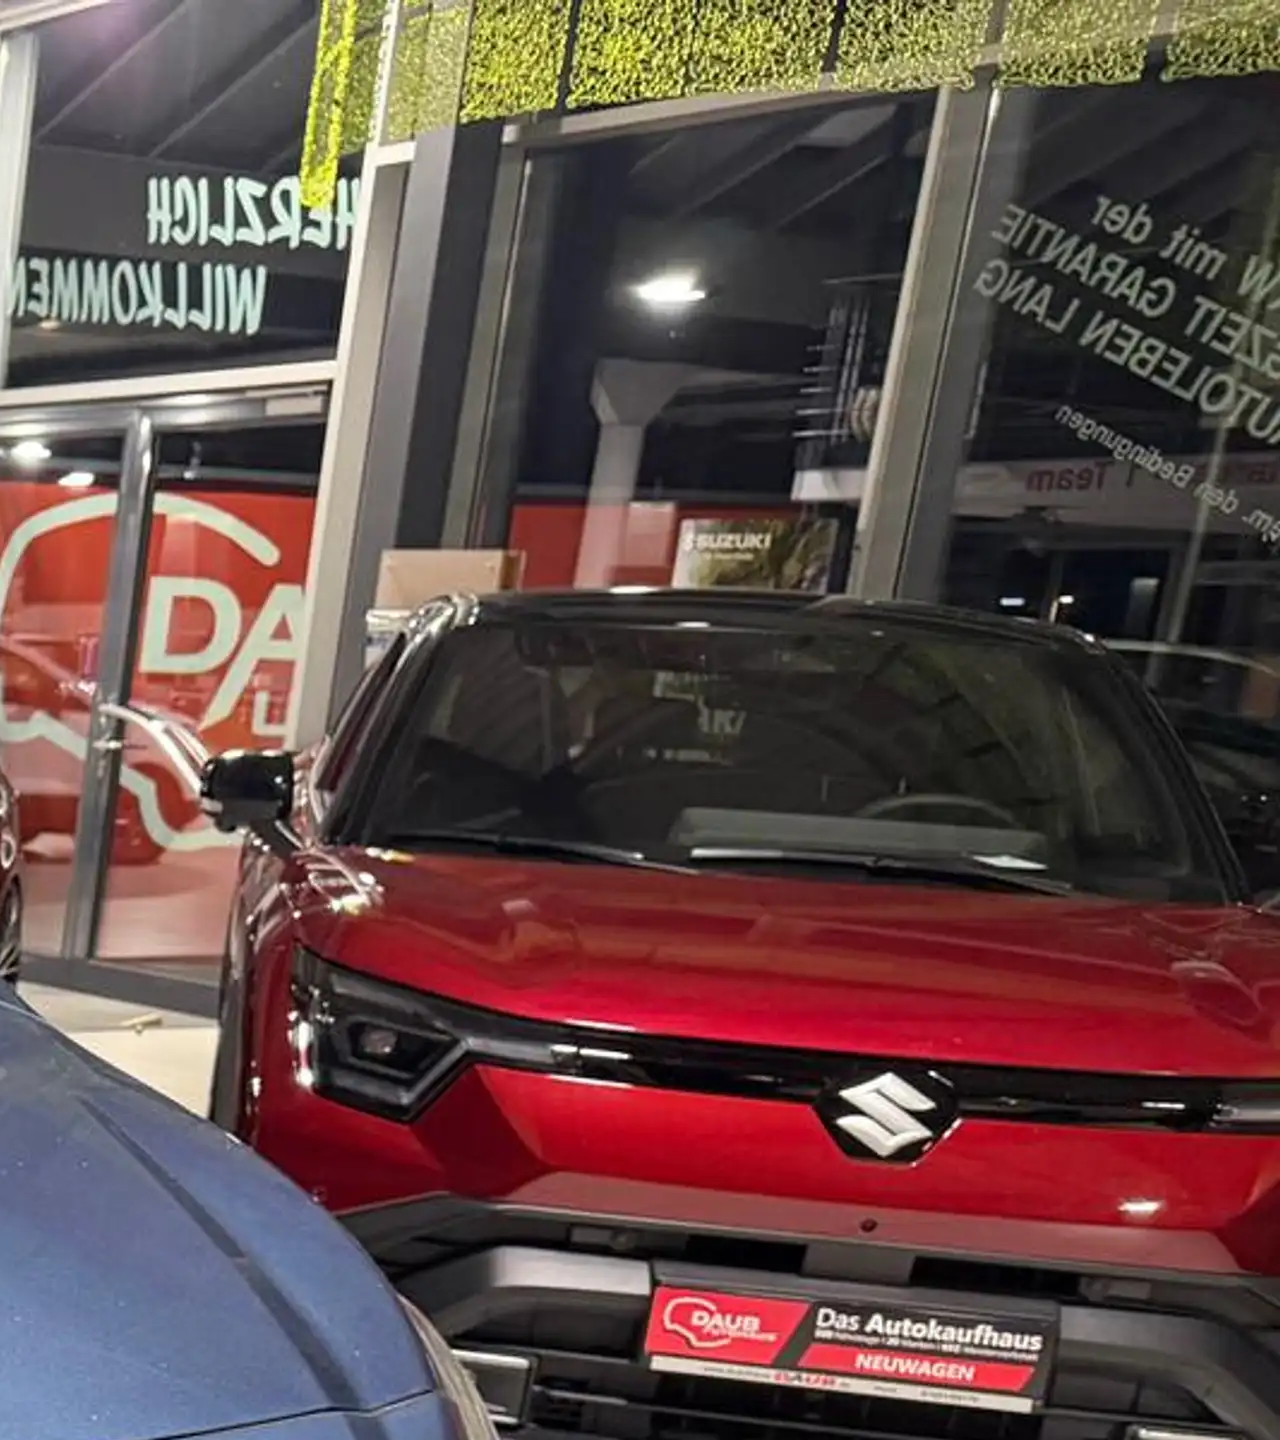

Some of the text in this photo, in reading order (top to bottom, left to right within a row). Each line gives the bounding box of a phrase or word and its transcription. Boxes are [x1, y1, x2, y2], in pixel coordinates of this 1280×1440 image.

[691, 1310, 760, 1332] DAUB
[816, 1308, 860, 1332] Das
[865, 1313, 1042, 1351] Autokaufhaus
[854, 1353, 975, 1382] NEUWAGEN
